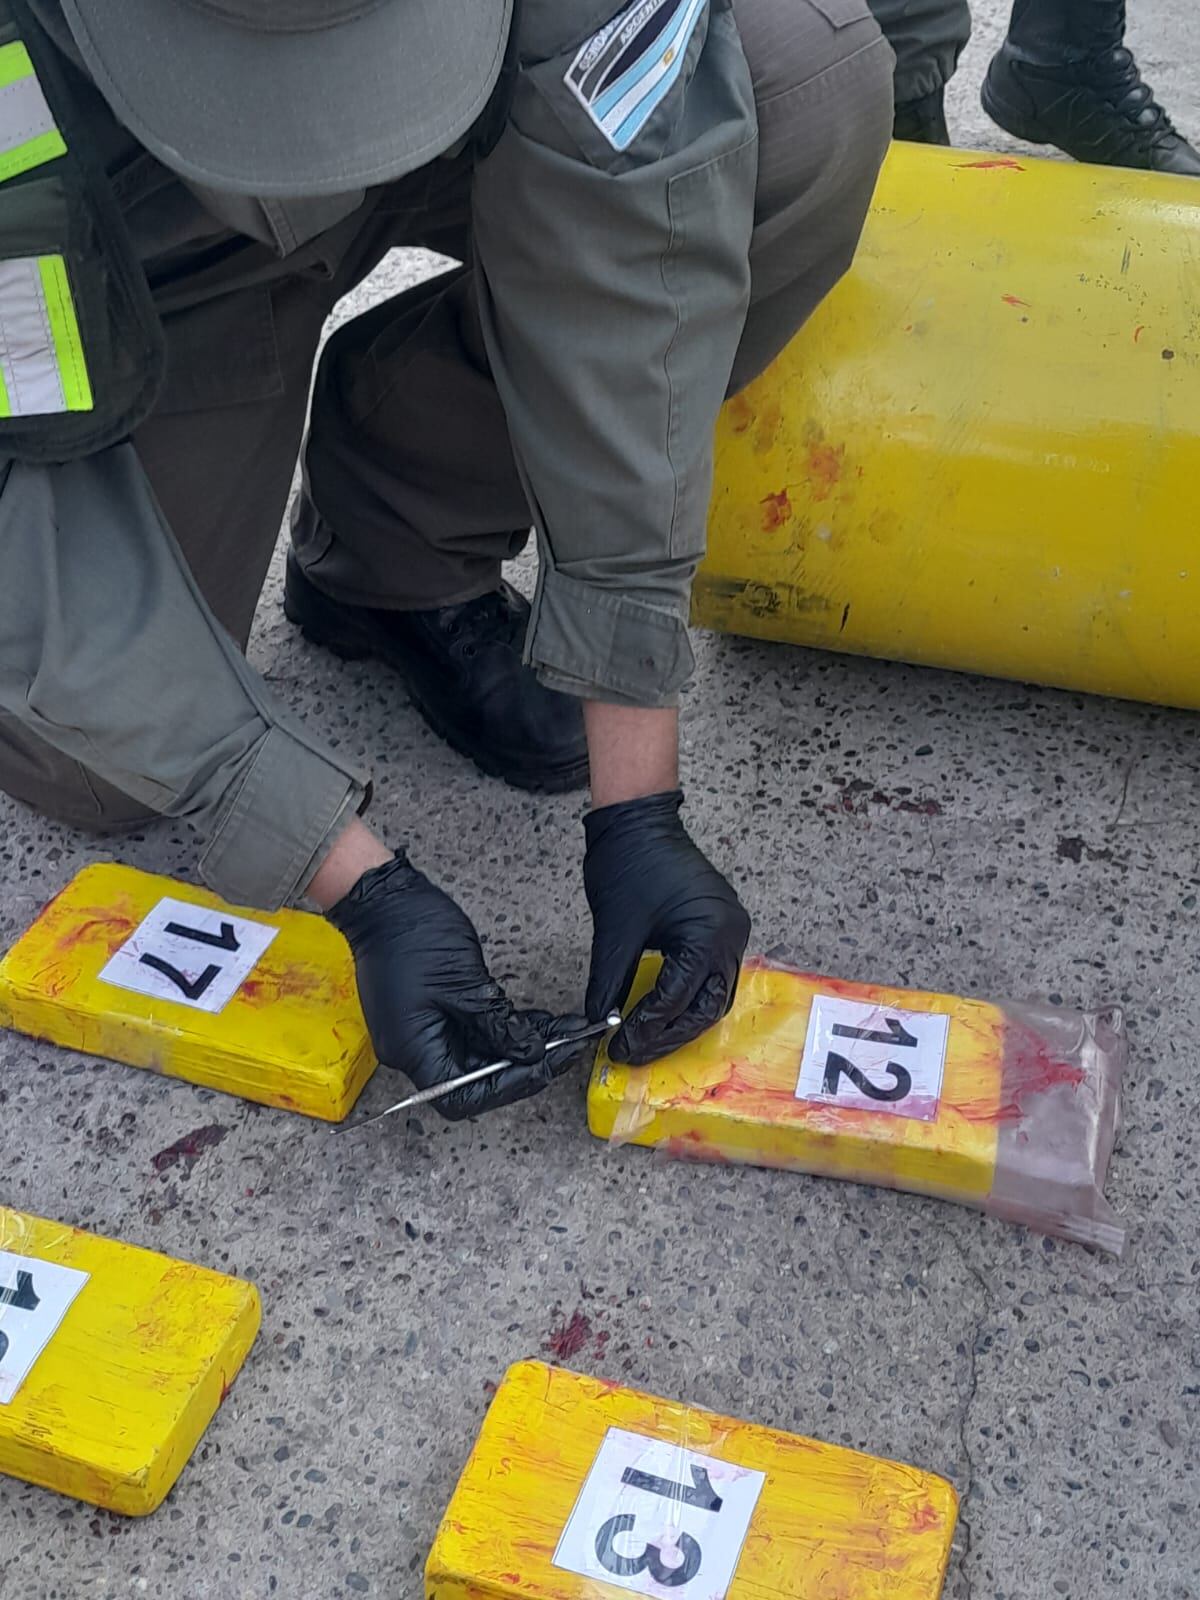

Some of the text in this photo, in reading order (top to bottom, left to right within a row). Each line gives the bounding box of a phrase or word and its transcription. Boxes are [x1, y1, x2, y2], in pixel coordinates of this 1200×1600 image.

[139, 921, 241, 1000] 17
[821, 1018, 918, 1102] 12
[0, 1270, 41, 1362] 1
[595, 1464, 723, 1587] 13
